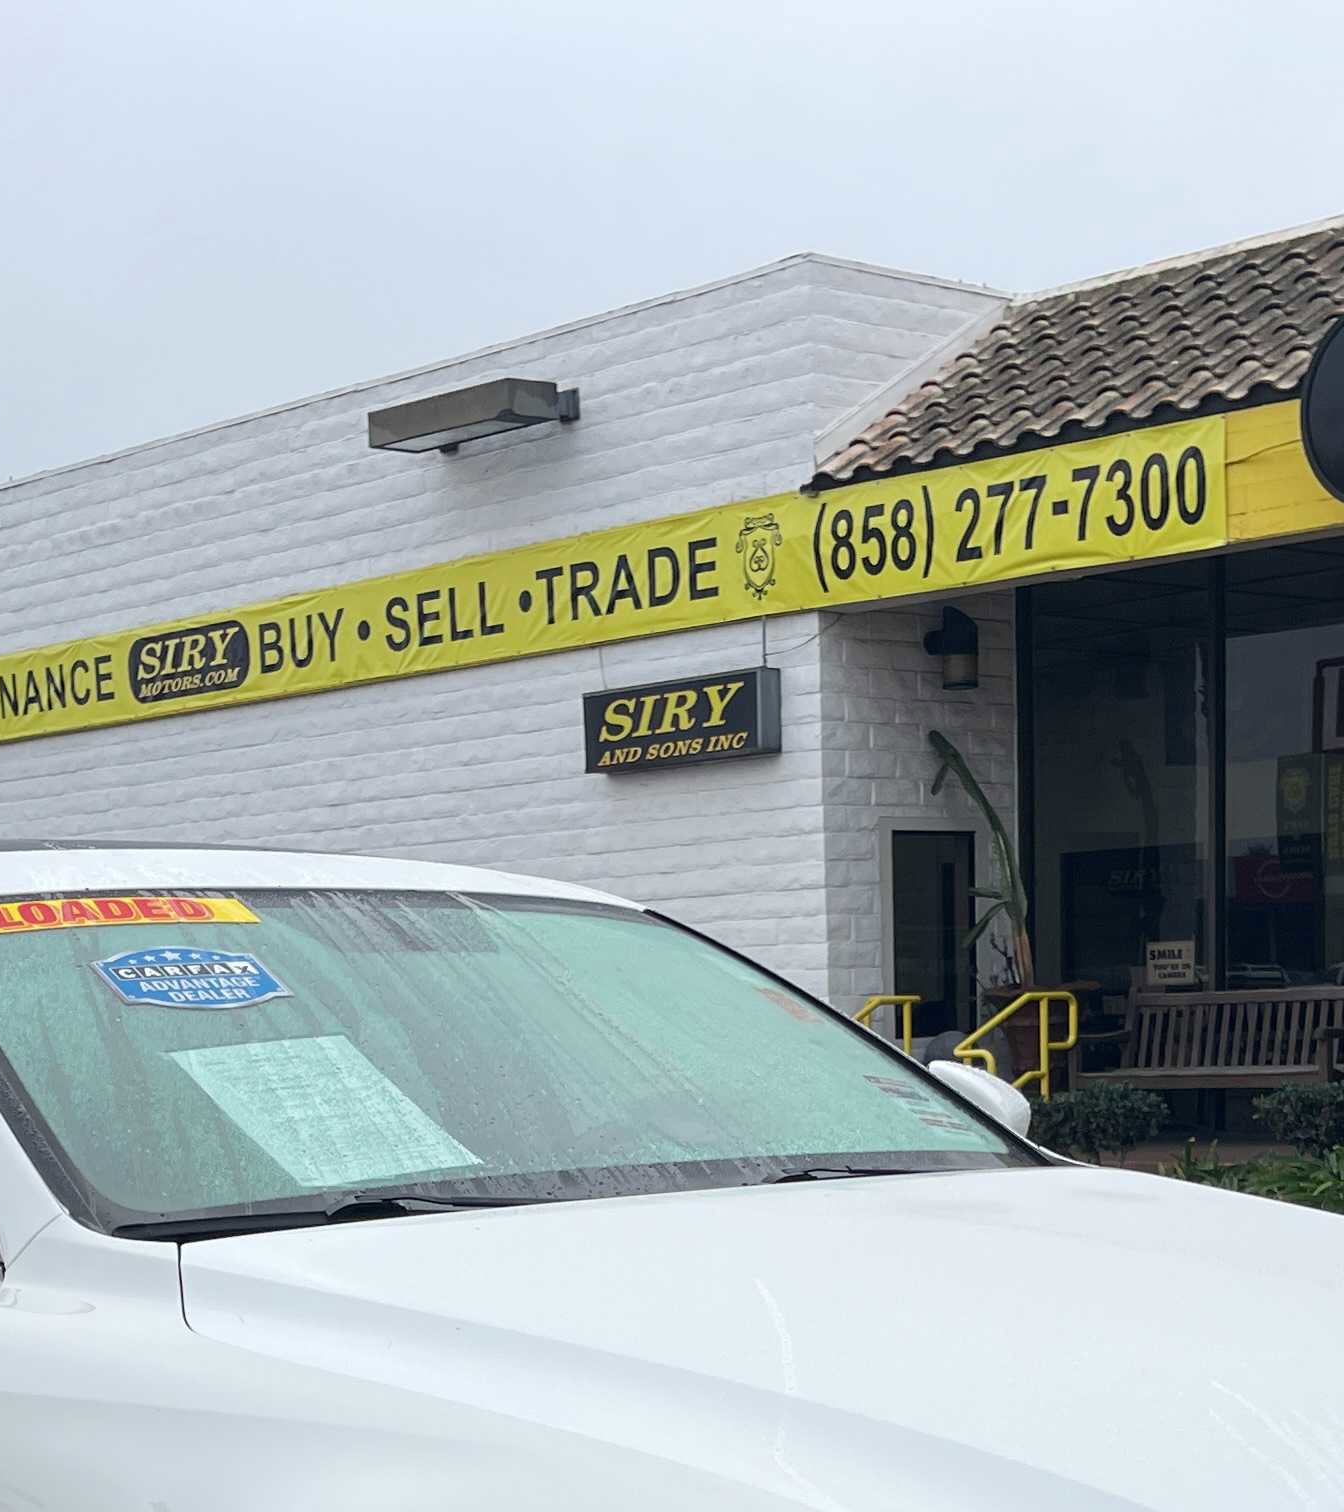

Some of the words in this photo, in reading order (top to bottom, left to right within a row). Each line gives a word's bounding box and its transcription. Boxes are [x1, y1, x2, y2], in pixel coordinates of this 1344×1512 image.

[813, 486, 934, 593] (858)
[955, 446, 1207, 562] 277-7300
[259, 608, 345, 675] BUY
[385, 581, 504, 652] SELL
[536, 536, 720, 625] TRADE
[137, 626, 239, 682] SIRY
[139, 666, 242, 697] MOTORS.COM
[599, 680, 744, 743] SIRY
[598, 747, 642, 767] AND
[646, 738, 703, 760] SONS
[706, 731, 748, 752] INC
[116, 962, 259, 980] CARFAX
[1149, 949, 1183, 960] SMILE
[140, 976, 261, 993] ADVANTAGE
[169, 988, 250, 1003] DEALER
